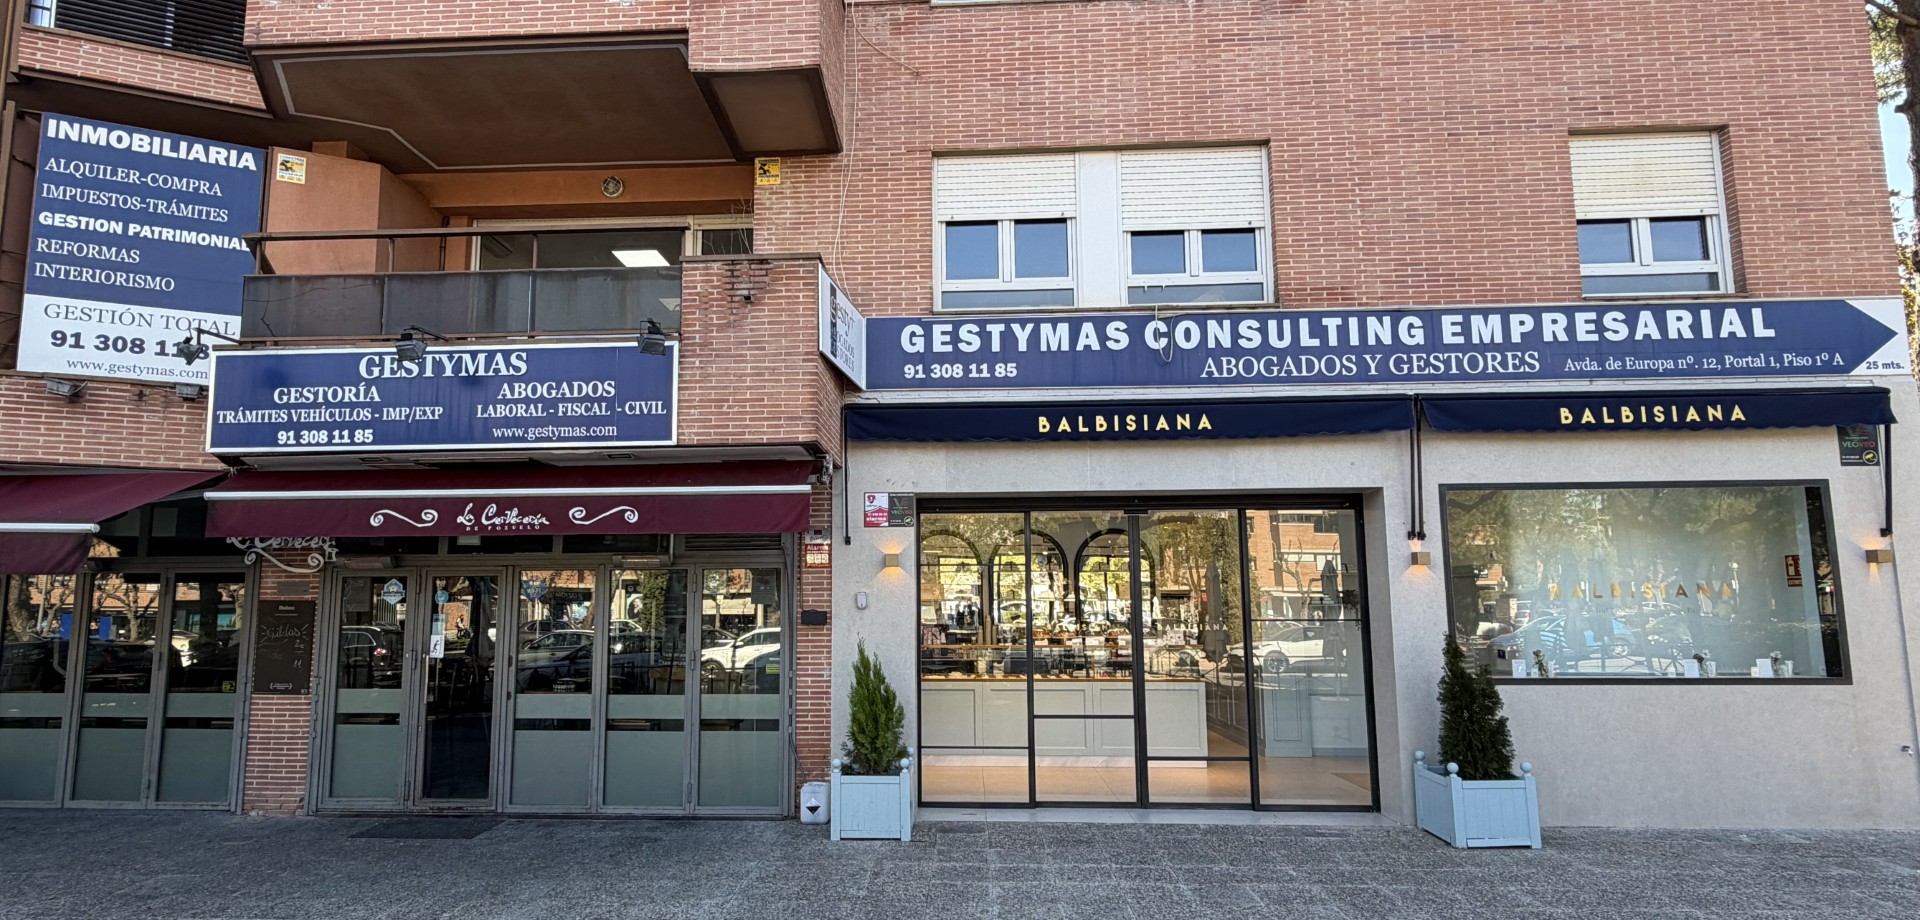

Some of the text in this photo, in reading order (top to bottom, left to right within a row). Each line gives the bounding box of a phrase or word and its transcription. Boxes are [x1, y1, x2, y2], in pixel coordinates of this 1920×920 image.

[47, 119, 257, 171] INMOBILIARIA
[44, 157, 223, 197] ALQUILER-COMPRA
[41, 183, 229, 223] IMPUESTOS-TRÁMITES
[38, 211, 250, 251] GESTION PATRIMONIAL
[36, 238, 140, 264] REFORMAS
[34, 262, 175, 292] INTERIORISMO
[43, 303, 236, 336] GESTIÓN TOTAL
[900, 307, 1775, 353] GESTYMAS CONSULTING EMPRESARIAL
[50, 329, 85, 350] 91
[93, 334, 146, 355] 308
[66, 359, 209, 379] www.gestymas.com
[359, 351, 528, 379] GESTYMAS
[903, 362, 1017, 379] 91 308 11 85
[1200, 351, 1540, 378] ABOGADOS Y GESTORES
[1564, 356, 1602, 372] Avda.
[1605, 356, 1622, 370] de
[1625, 356, 1675, 373] Europa
[1702, 358, 1721, 371] 12,
[1725, 353, 1765, 368] Portal
[1769, 356, 1780, 369] 1,
[1783, 353, 1812, 367] Piso
[1833, 353, 1844, 366] A
[1865, 360, 1904, 370] 25 mts.
[273, 382, 381, 403] GESTORÍA
[497, 380, 615, 399] ABOGADOS
[217, 407, 288, 424] TRÁMITES
[290, 405, 372, 422] VEHÍCULOS
[382, 406, 443, 423] IMP/EXP
[476, 403, 546, 418] LABORAL
[557, 402, 610, 417] FISCAL
[625, 401, 666, 415] CIVIL
[1559, 404, 1746, 424] BALBISIANA
[493, 424, 617, 440] www.gestymas.com
[1038, 413, 1212, 433] BALBISIANA
[277, 429, 373, 444] 91 308 11 85
[457, 503, 475, 526] La
[1548, 581, 1732, 600] BALBISIANA
